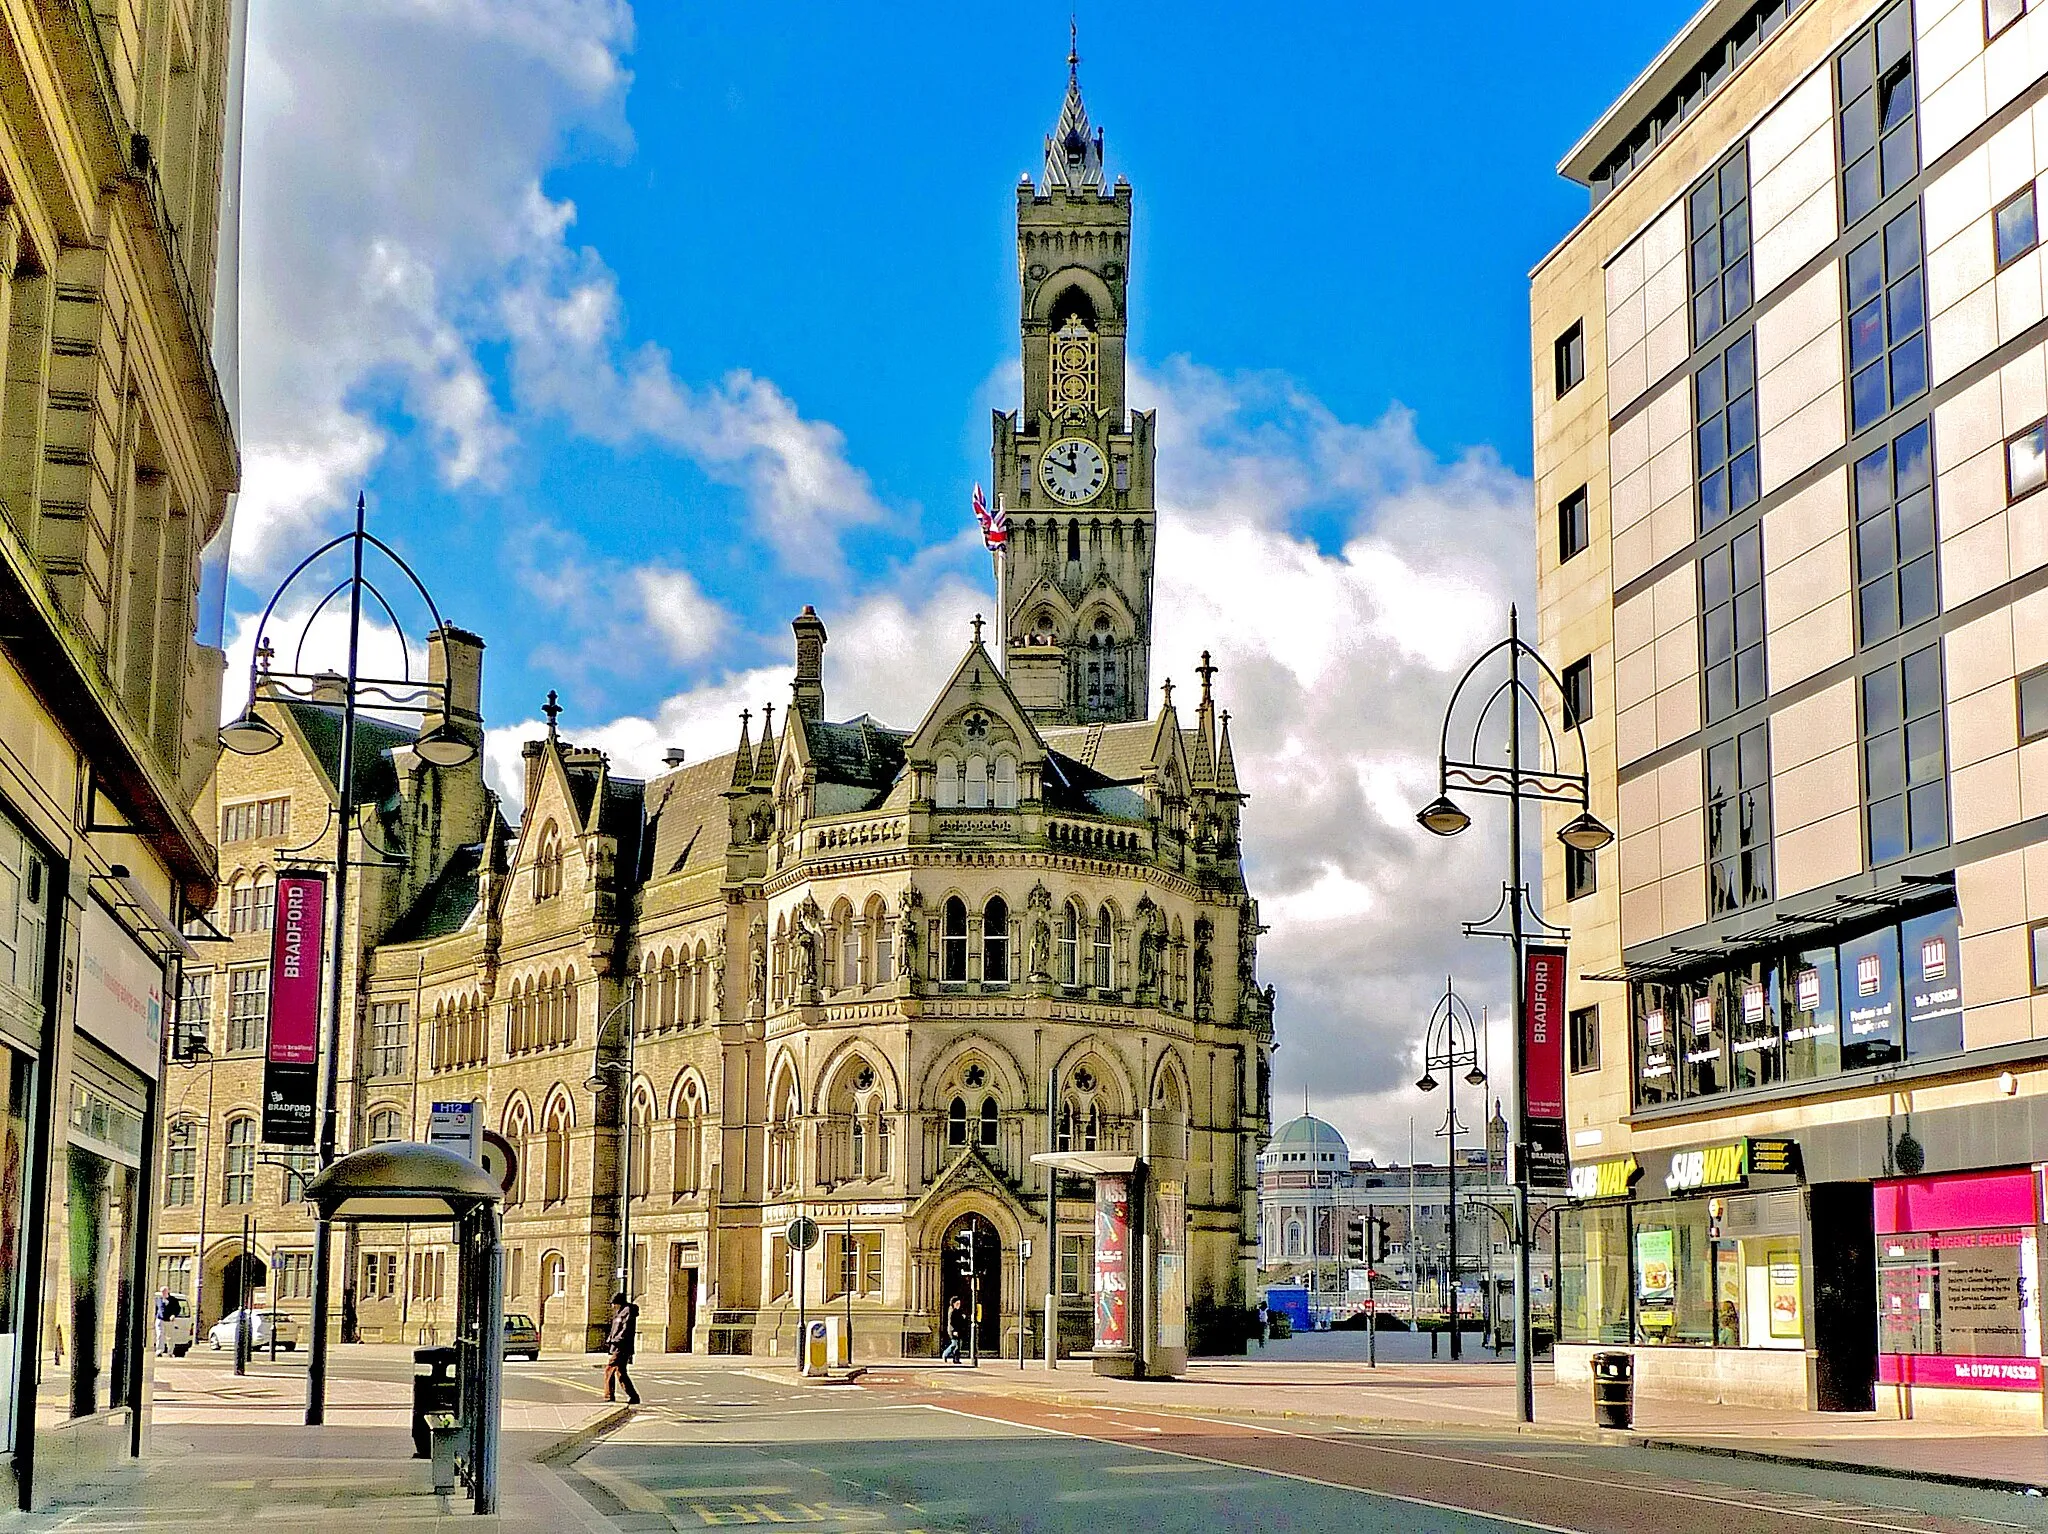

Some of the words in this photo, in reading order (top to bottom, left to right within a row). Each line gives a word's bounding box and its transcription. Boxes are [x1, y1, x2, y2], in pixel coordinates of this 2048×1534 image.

[283, 886, 304, 979] BRADFORD
[1534, 961, 1548, 1044] BRADFORD
[268, 1103, 311, 1112] BRADFORD
[440, 1103, 463, 1113] H12
[1566, 1154, 1637, 1200] SUBWAY
[1666, 1144, 1745, 1189] SUBWAY
[1923, 1234, 1976, 1249] NEGLIGENCE
[1954, 1363, 1970, 1378] Tel:
[1971, 1364, 2000, 1378] 01274
